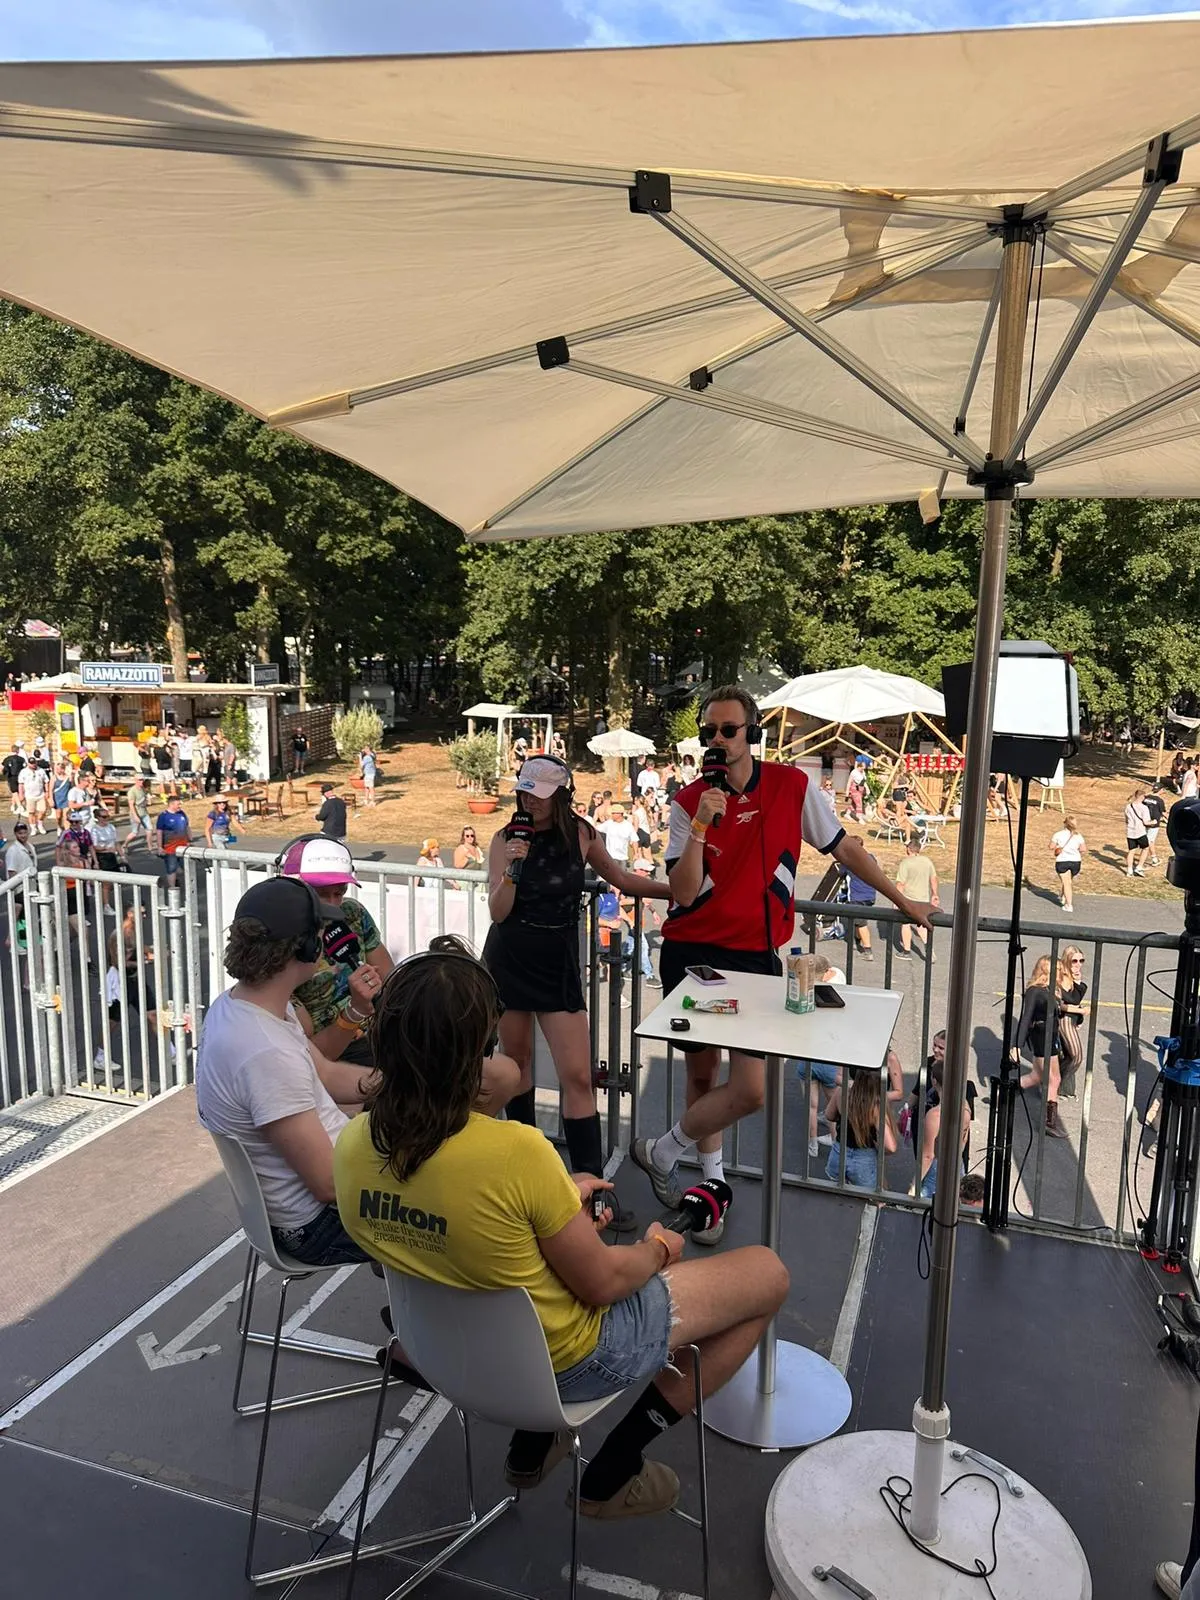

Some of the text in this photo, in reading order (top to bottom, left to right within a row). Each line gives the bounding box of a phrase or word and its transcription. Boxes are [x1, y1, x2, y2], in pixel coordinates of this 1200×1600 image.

[85, 667, 159, 682] RAMAZZOTTI
[359, 1189, 448, 1236] Nikon
[366, 1219, 381, 1230] We
[381, 1221, 399, 1234] take
[400, 1223, 415, 1237] the
